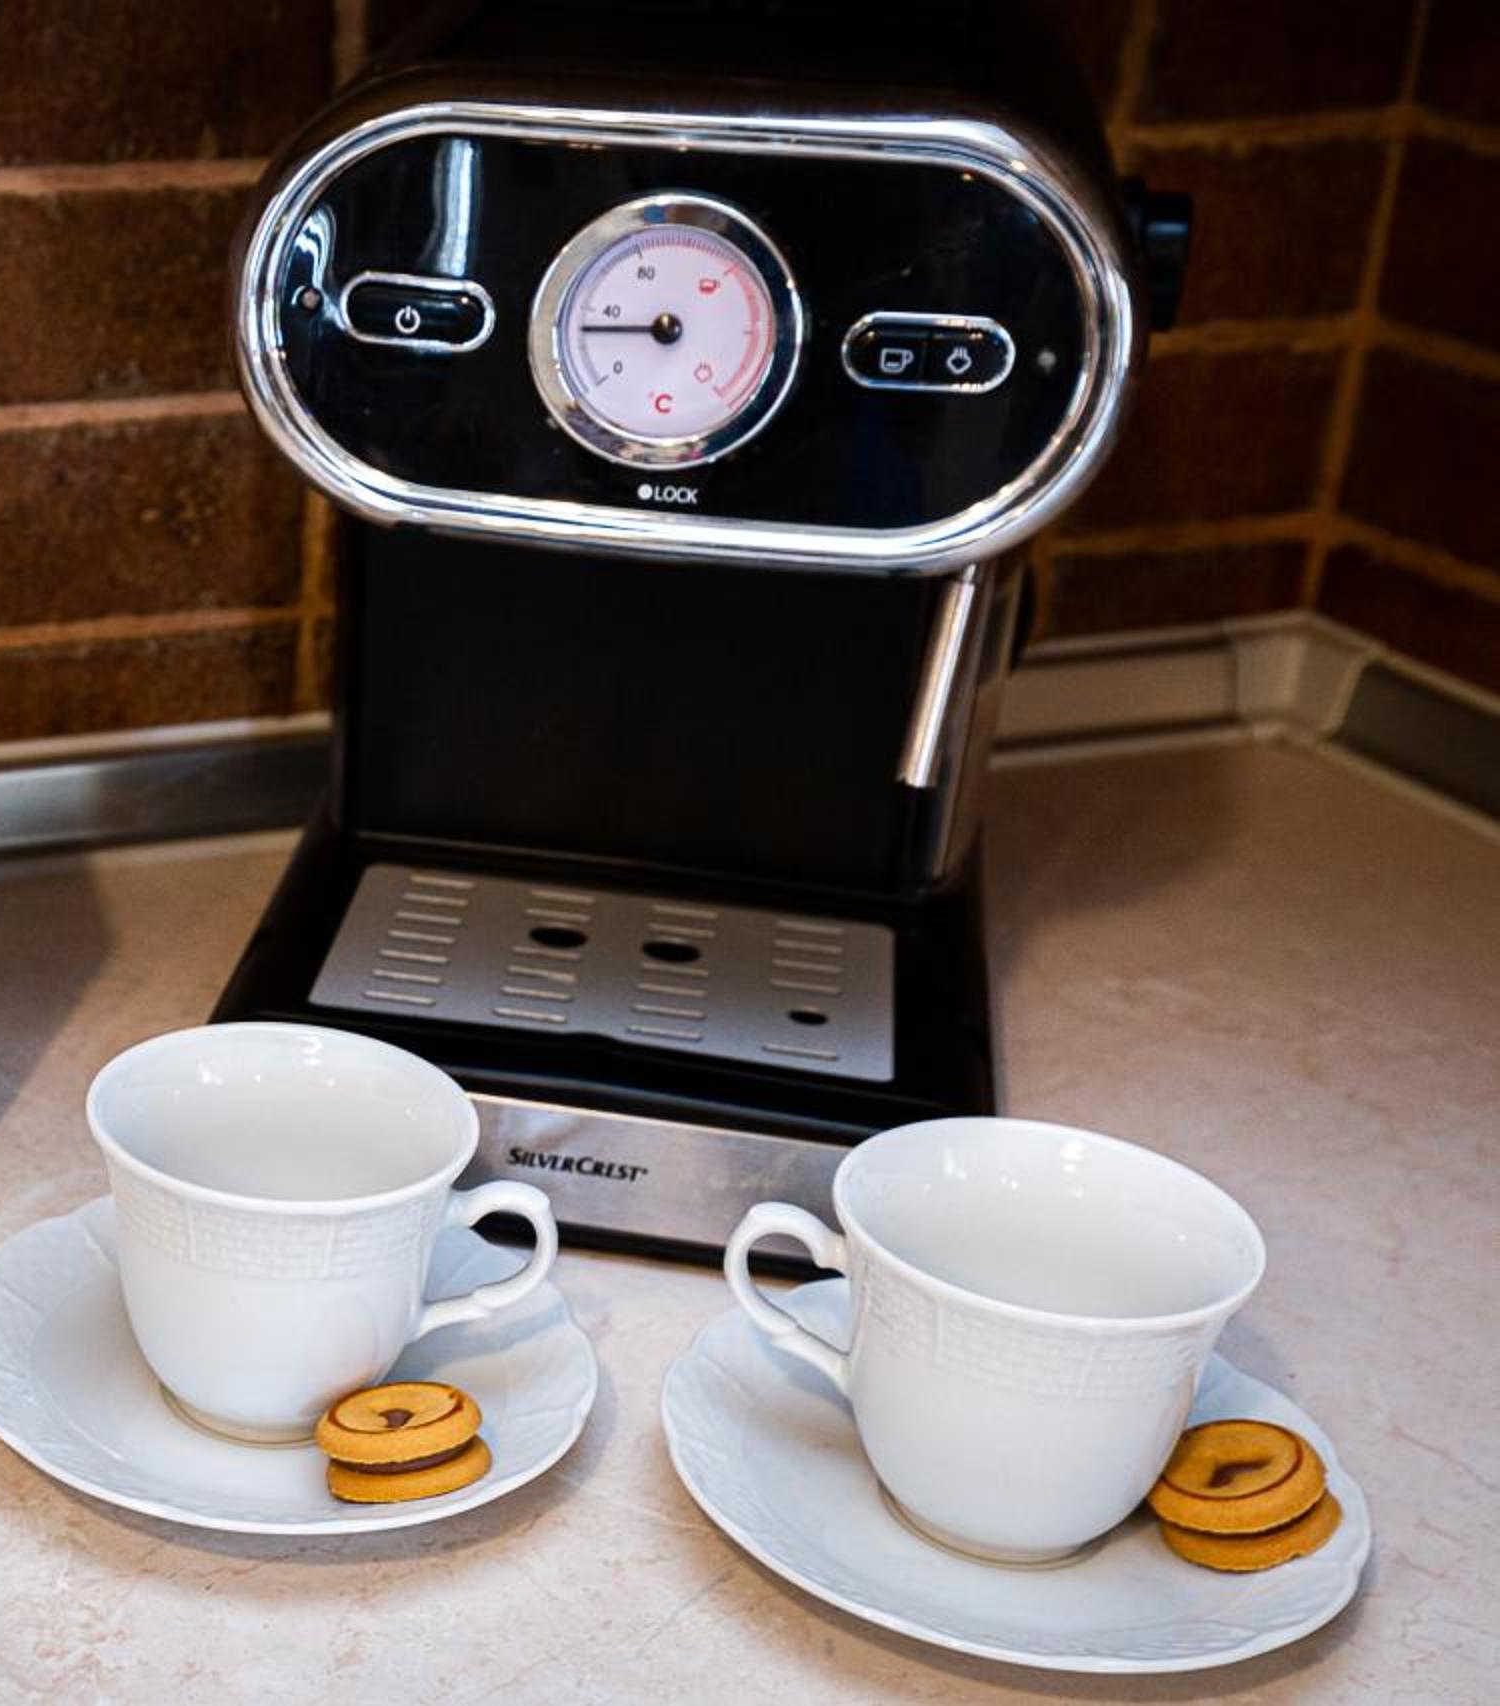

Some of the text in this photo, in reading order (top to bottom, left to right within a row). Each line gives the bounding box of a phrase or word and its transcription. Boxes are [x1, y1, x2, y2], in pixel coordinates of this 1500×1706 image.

[637, 266, 655, 281] 80
[603, 304, 621, 318] 40
[613, 362, 623, 375] 0
[654, 486, 699, 504] LOCK
